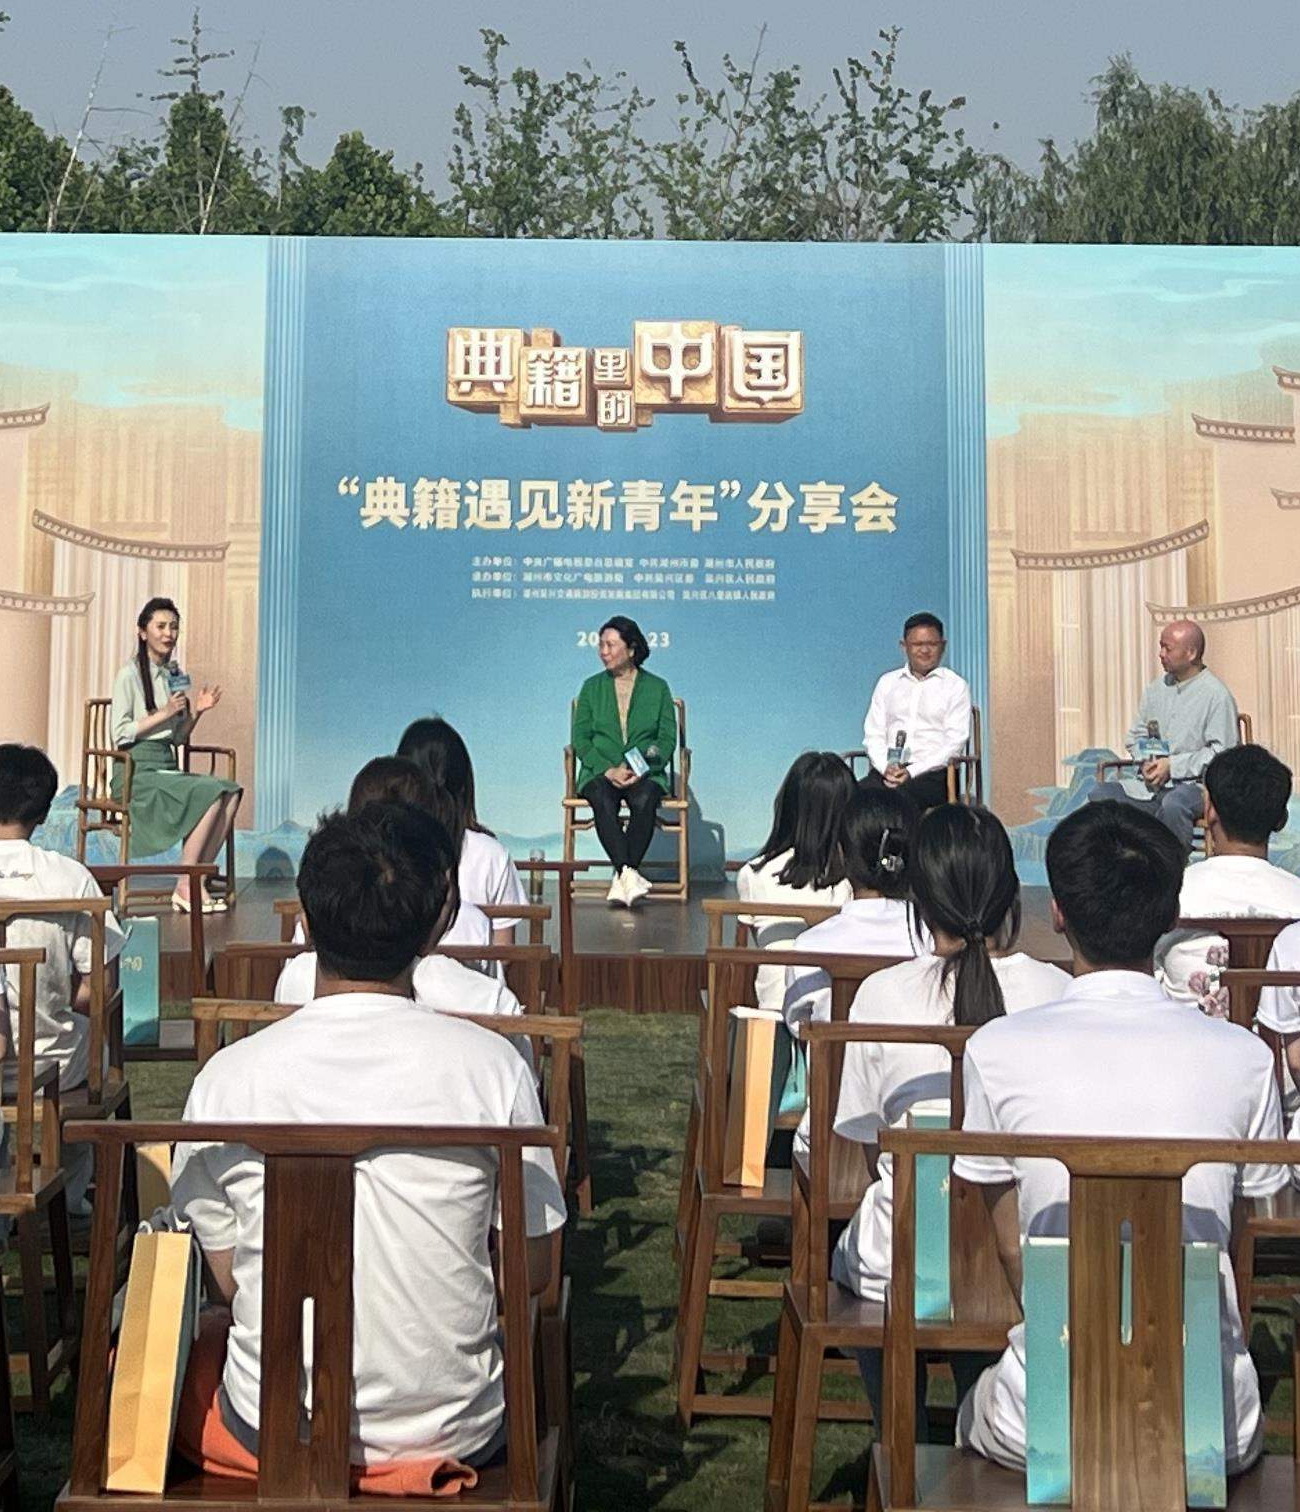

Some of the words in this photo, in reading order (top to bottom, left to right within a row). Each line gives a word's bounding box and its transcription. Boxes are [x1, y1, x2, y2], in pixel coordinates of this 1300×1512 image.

[450, 322, 798, 427] 典籍里的中国
[336, 477, 898, 533] “典籍遇见新青年”分享会
